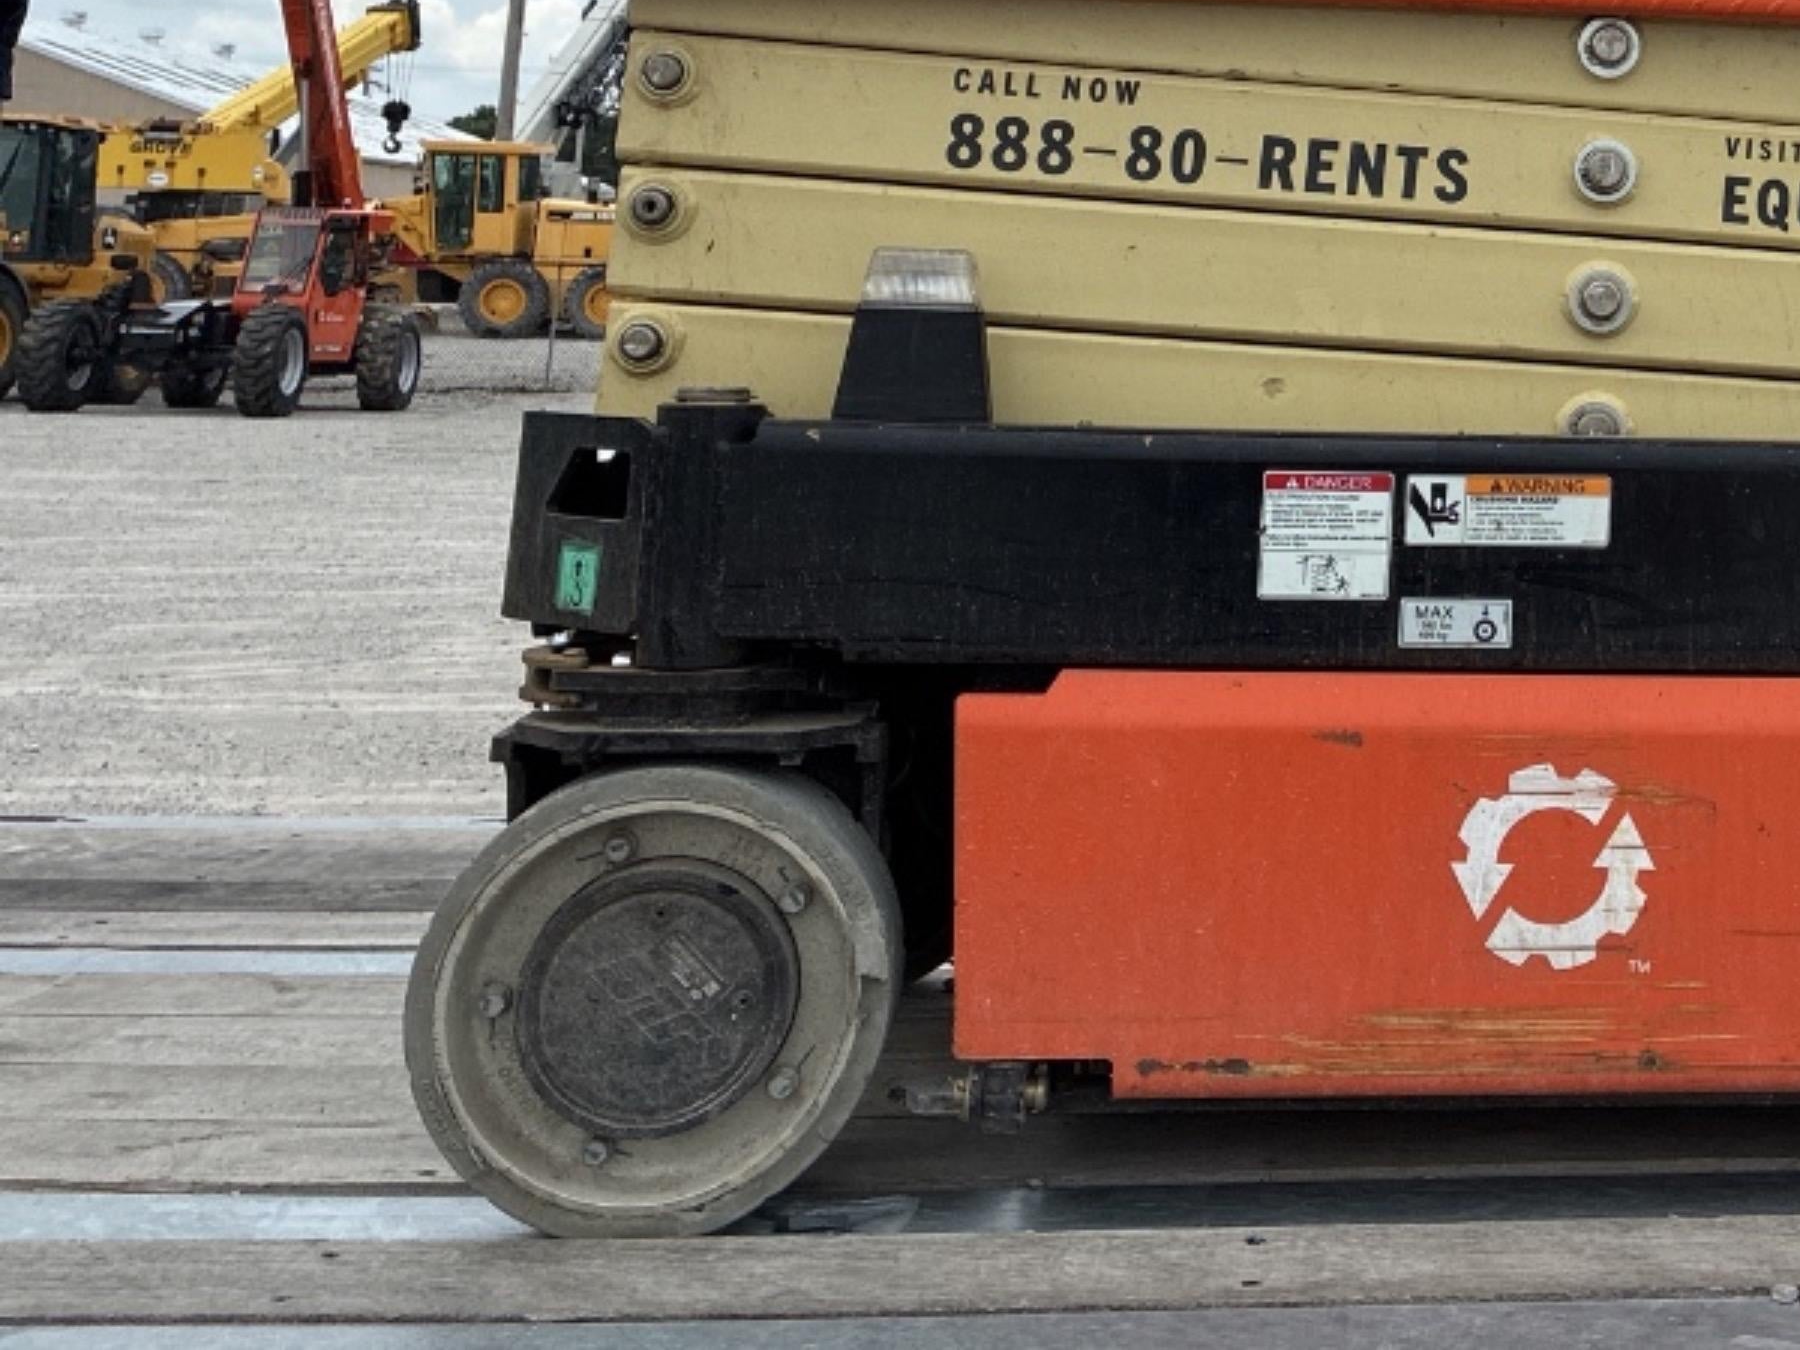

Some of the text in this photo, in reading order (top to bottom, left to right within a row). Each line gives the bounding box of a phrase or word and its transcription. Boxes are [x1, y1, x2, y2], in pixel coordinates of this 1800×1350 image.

[953, 68, 1142, 105] CALL NOW
[945, 113, 1470, 204] 888-80-RENTS
[1303, 476, 1373, 489] DANGER
[1504, 479, 1585, 493] WARNING
[1415, 605, 1454, 619] MAX
